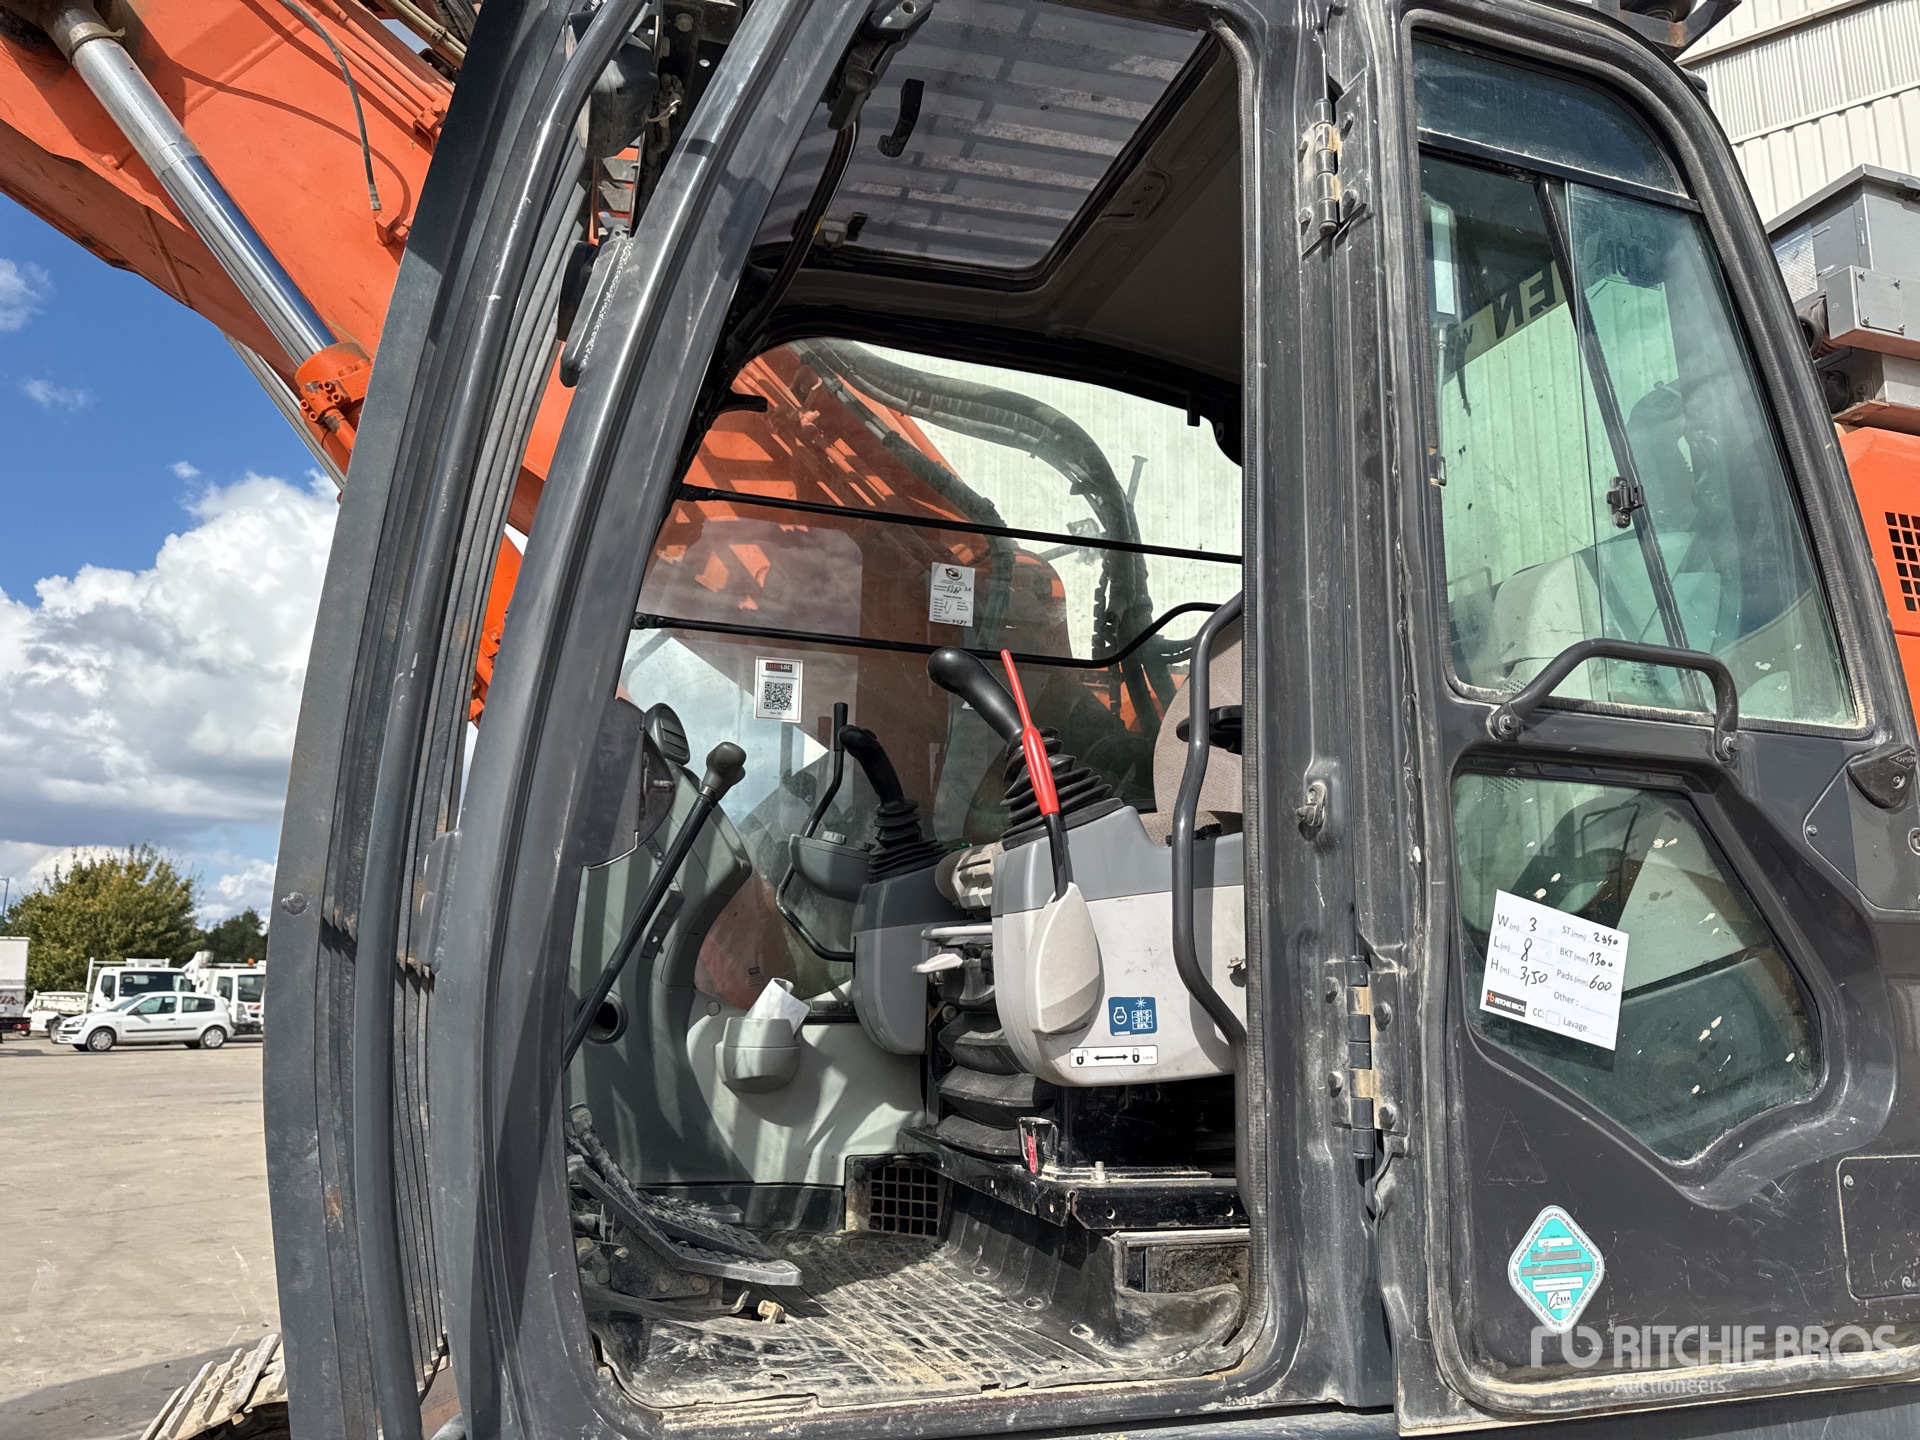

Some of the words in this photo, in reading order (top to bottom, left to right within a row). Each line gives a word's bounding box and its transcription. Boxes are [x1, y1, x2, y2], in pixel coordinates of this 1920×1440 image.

[1529, 917, 1537, 931] 3
[1521, 938, 1532, 962] 8
[1560, 947, 1573, 958] BKT
[1490, 958, 1499, 970] H
[1588, 952, 1613, 967] 1300
[1520, 966, 1548, 986] 3,50
[1557, 969, 1573, 981] Pads
[1589, 975, 1612, 991] 600
[1553, 992, 1575, 1005] Other
[1533, 1008, 1545, 1018] CC:
[1515, 1241, 1531, 1264] Certificate
[1540, 1212, 1566, 1226] Construction
[1584, 1244, 1597, 1259] Export
[1520, 1284, 1543, 1313] CONSTRUCTION
[1543, 1311, 1564, 1327] EQUIPMENT
